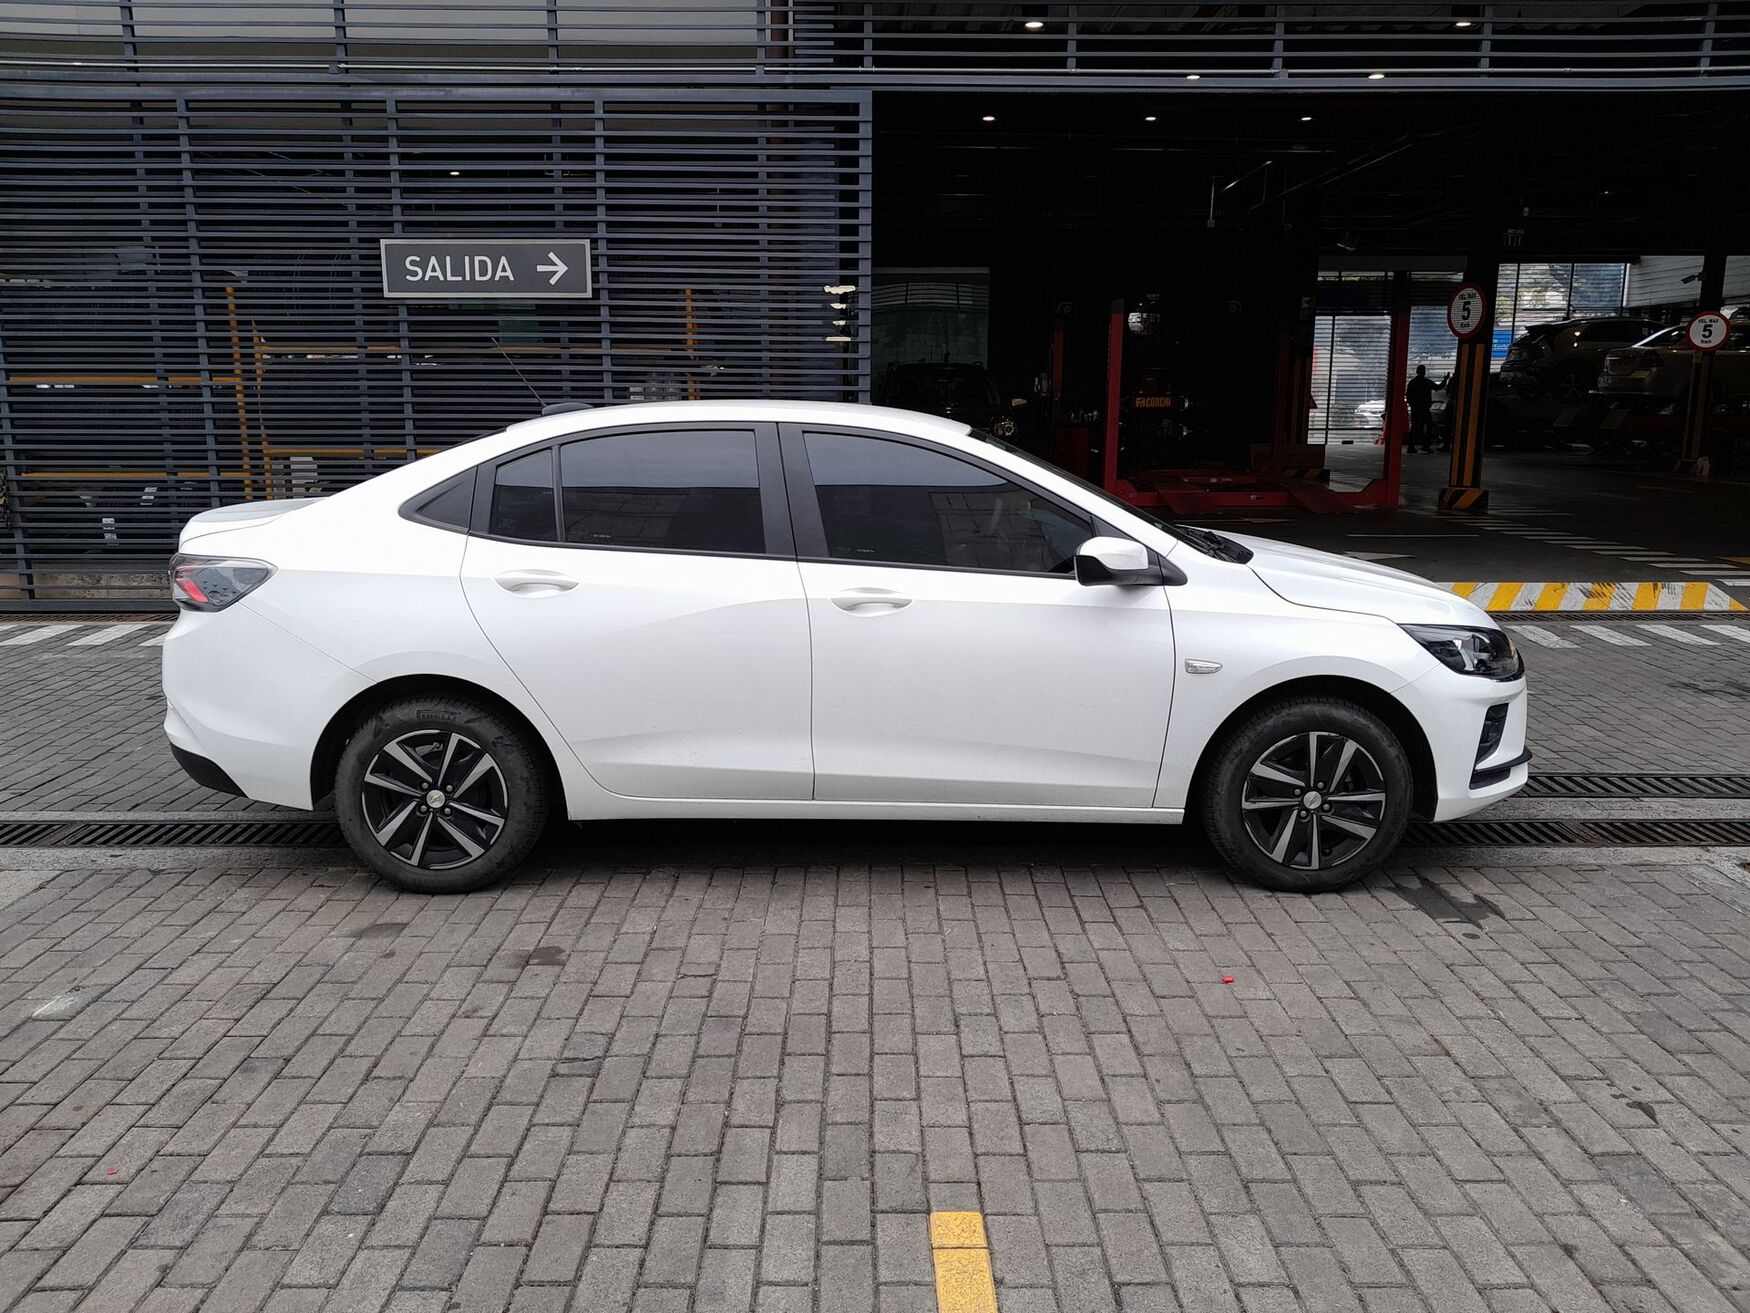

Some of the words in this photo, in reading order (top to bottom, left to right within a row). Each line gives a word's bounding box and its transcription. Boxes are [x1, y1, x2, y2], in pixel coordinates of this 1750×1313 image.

[405, 255, 515, 281] SALIDA
[1462, 300, 1470, 320] 5
[1702, 324, 1713, 338] 5
